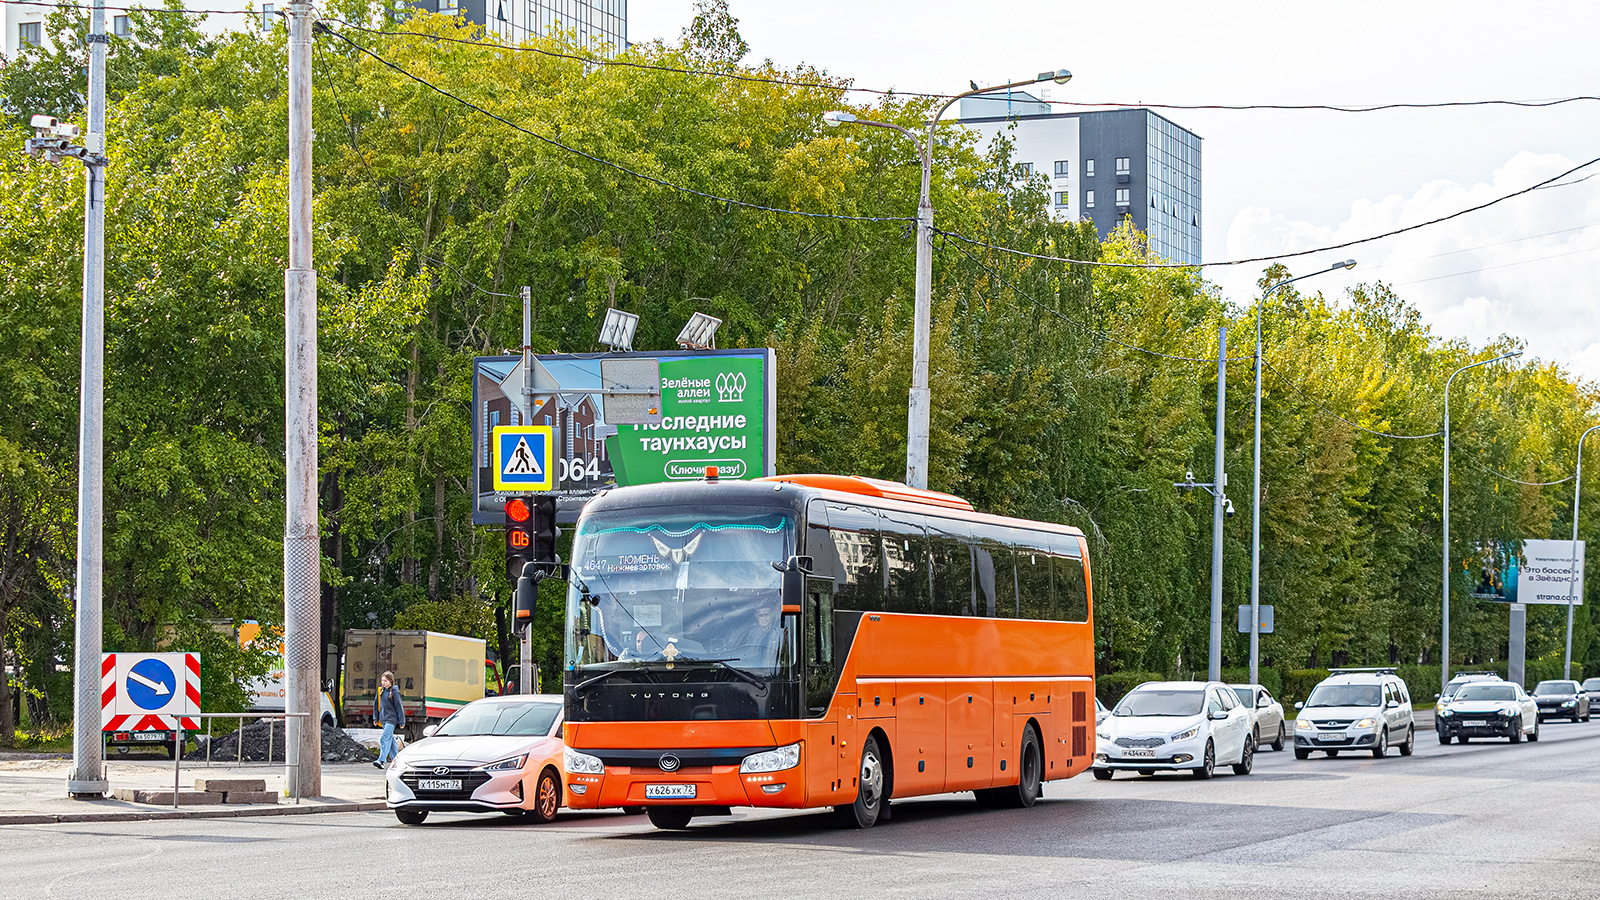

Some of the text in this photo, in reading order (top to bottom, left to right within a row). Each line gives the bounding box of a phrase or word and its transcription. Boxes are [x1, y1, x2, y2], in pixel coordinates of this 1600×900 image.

[662, 377, 711, 389] Зелёные
[677, 389, 711, 398] аллеи
[639, 435, 747, 455] таунхаусы
[671, 463, 741, 476] Ключи азу!
[512, 530, 530, 547] 06
[584, 559, 607, 571] 4647
[618, 554, 660, 565] ТЮМЕНЬ
[1525, 566, 1541, 574] Это
[684, 785, 693, 793] 72
